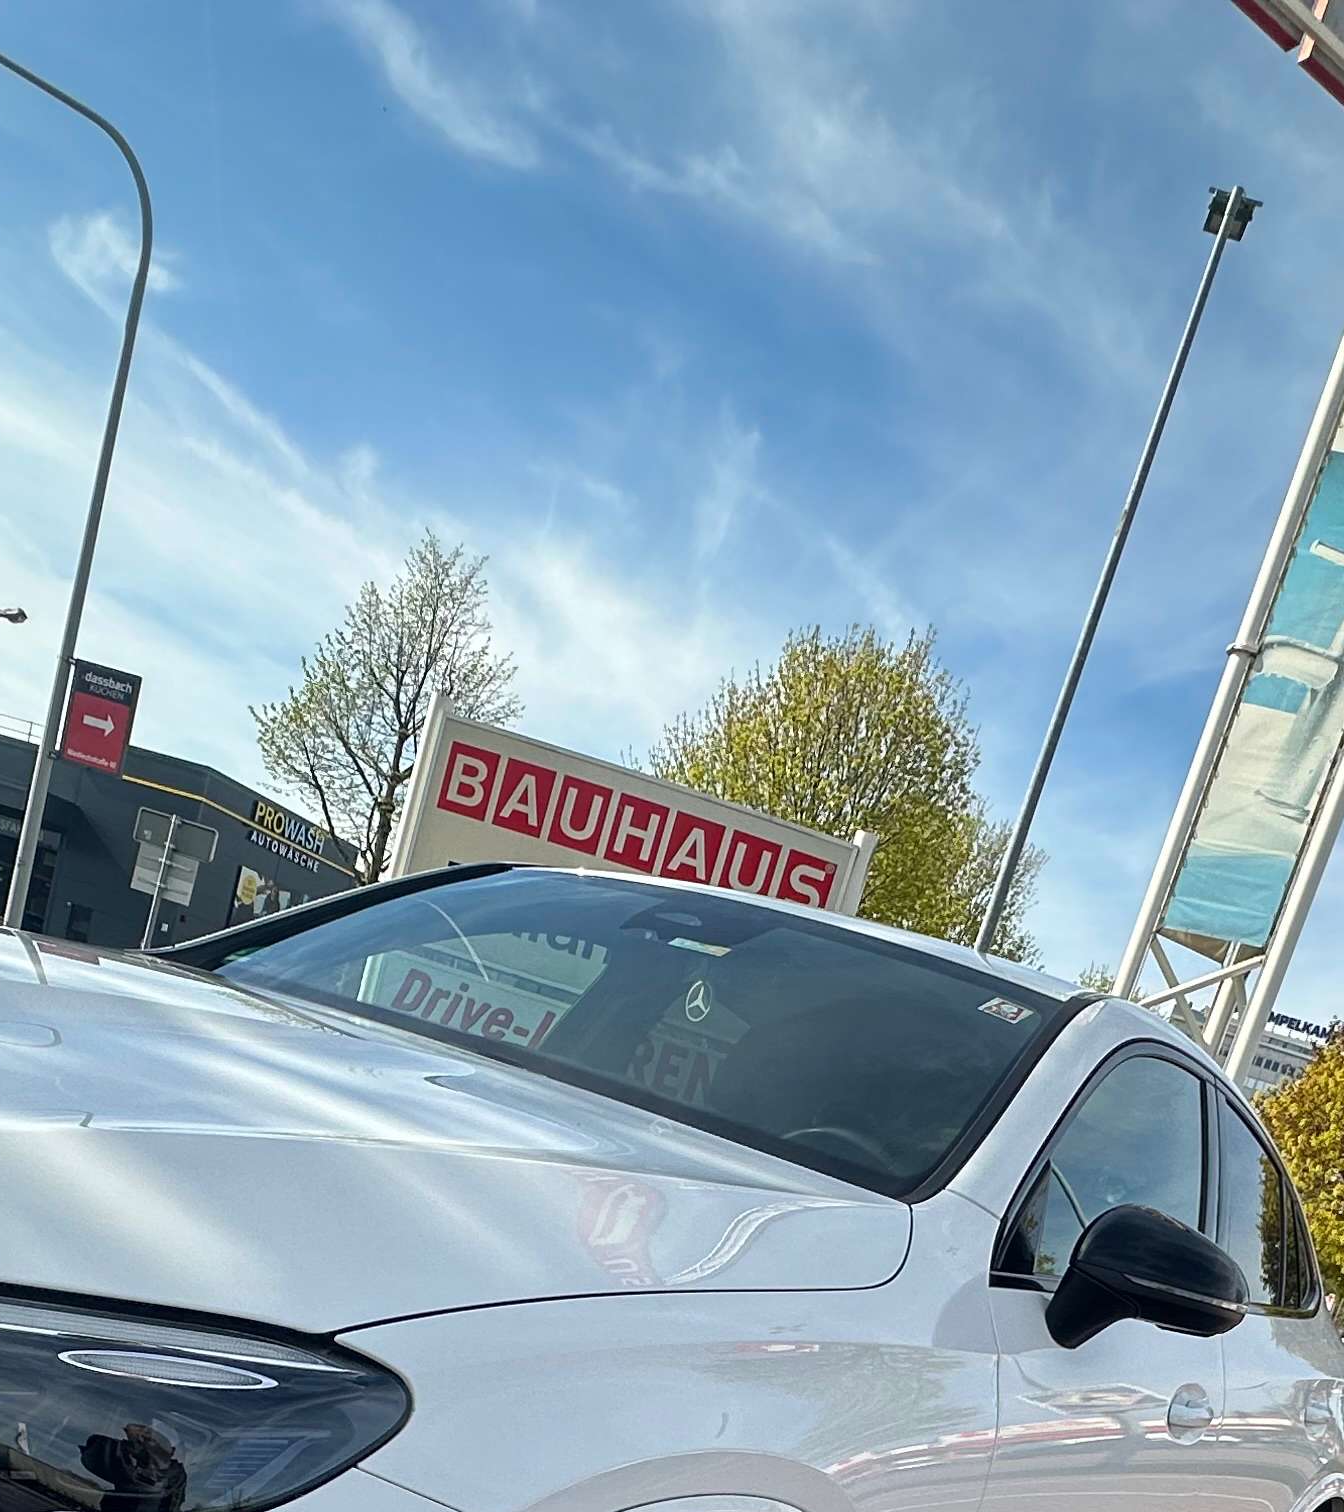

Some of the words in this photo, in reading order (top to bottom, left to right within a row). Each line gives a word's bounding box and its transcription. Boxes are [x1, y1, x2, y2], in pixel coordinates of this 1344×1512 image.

[254, 801, 325, 855] PROWASH
[445, 754, 835, 908] BAUHAUS
[391, 968, 557, 1050] Drive-I
[1267, 1010, 1331, 1041] MPELKAM
